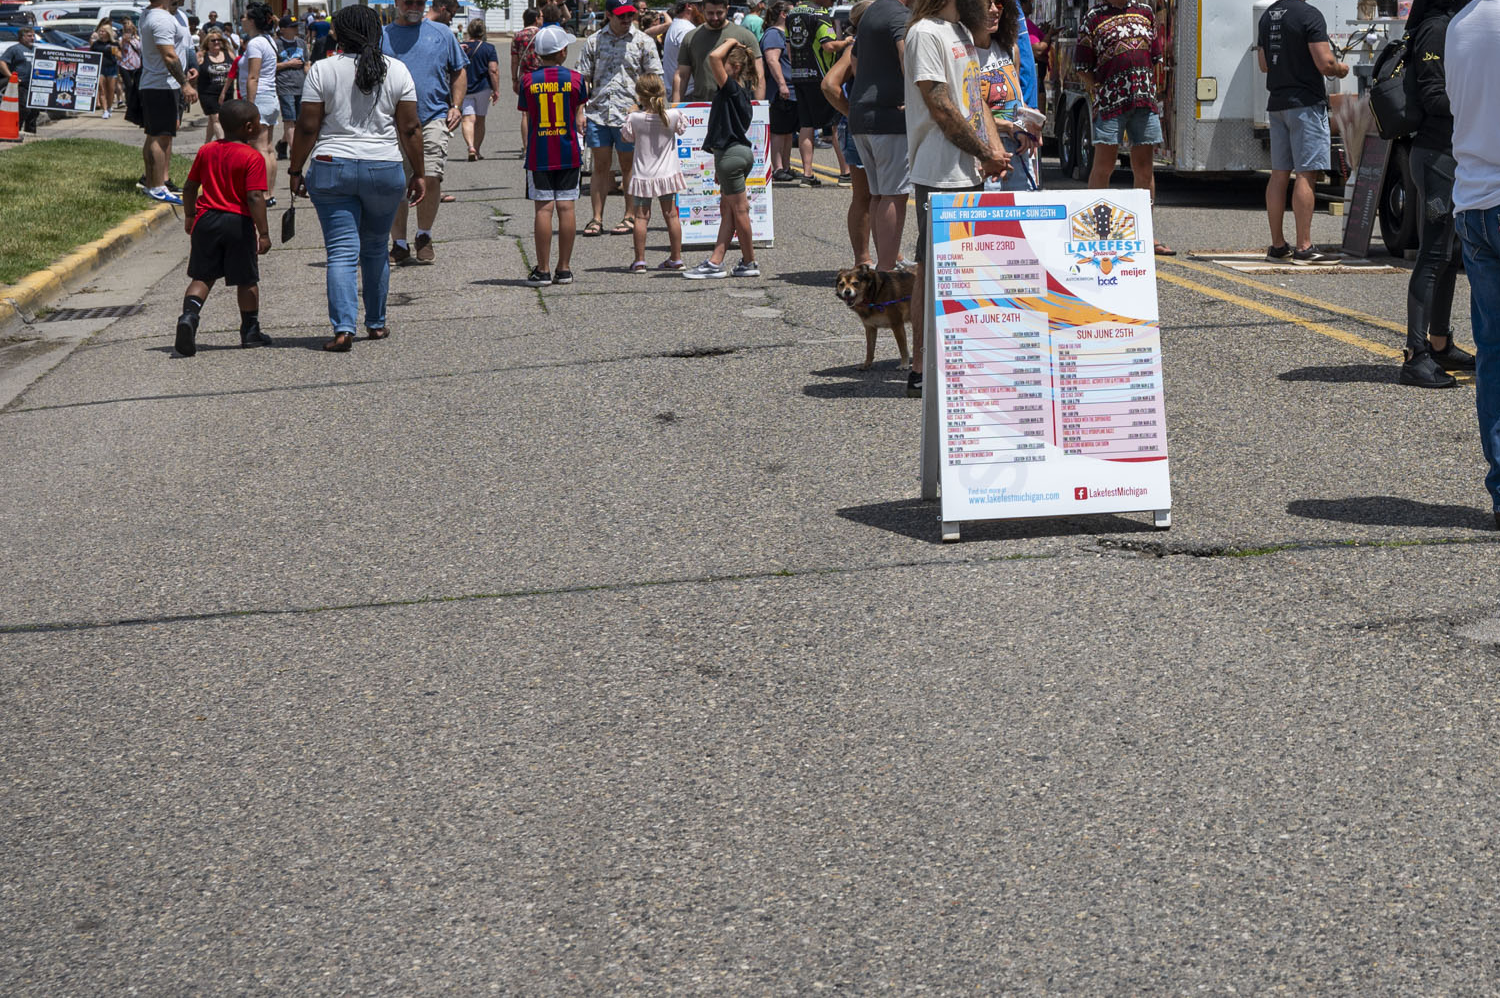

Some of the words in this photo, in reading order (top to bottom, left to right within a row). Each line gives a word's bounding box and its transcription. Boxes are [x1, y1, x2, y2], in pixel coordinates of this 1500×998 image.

[530, 82, 558, 94] NEYMAR
[562, 82, 571, 92] JR
[539, 93, 566, 128] 11
[538, 128, 558, 136] unicef
[940, 210, 957, 220] JUNE
[960, 210, 969, 219] FRI
[971, 209, 987, 218] 23RD
[992, 209, 1004, 218] SAT
[1005, 208, 1021, 218] 24TH
[1026, 208, 1039, 217] SUN
[1040, 208, 1056, 217] 25TH
[962, 242, 973, 252] FRI
[975, 242, 995, 251] JUNE
[997, 241, 1016, 251] 23RD
[1068, 241, 1141, 253] LAKEFEST
[1121, 268, 1146, 277] meijer
[965, 314, 979, 324] SAT
[981, 314, 999, 324] JUNE
[1002, 313, 1020, 323] 24TH
[1077, 330, 1092, 340] SUN
[1093, 329, 1113, 339] JUNE
[1115, 329, 1133, 338] 25TH
[1090, 487, 1147, 498] LakefestMichigan
[969, 492, 1060, 505] www.lakefestmichigan.com
